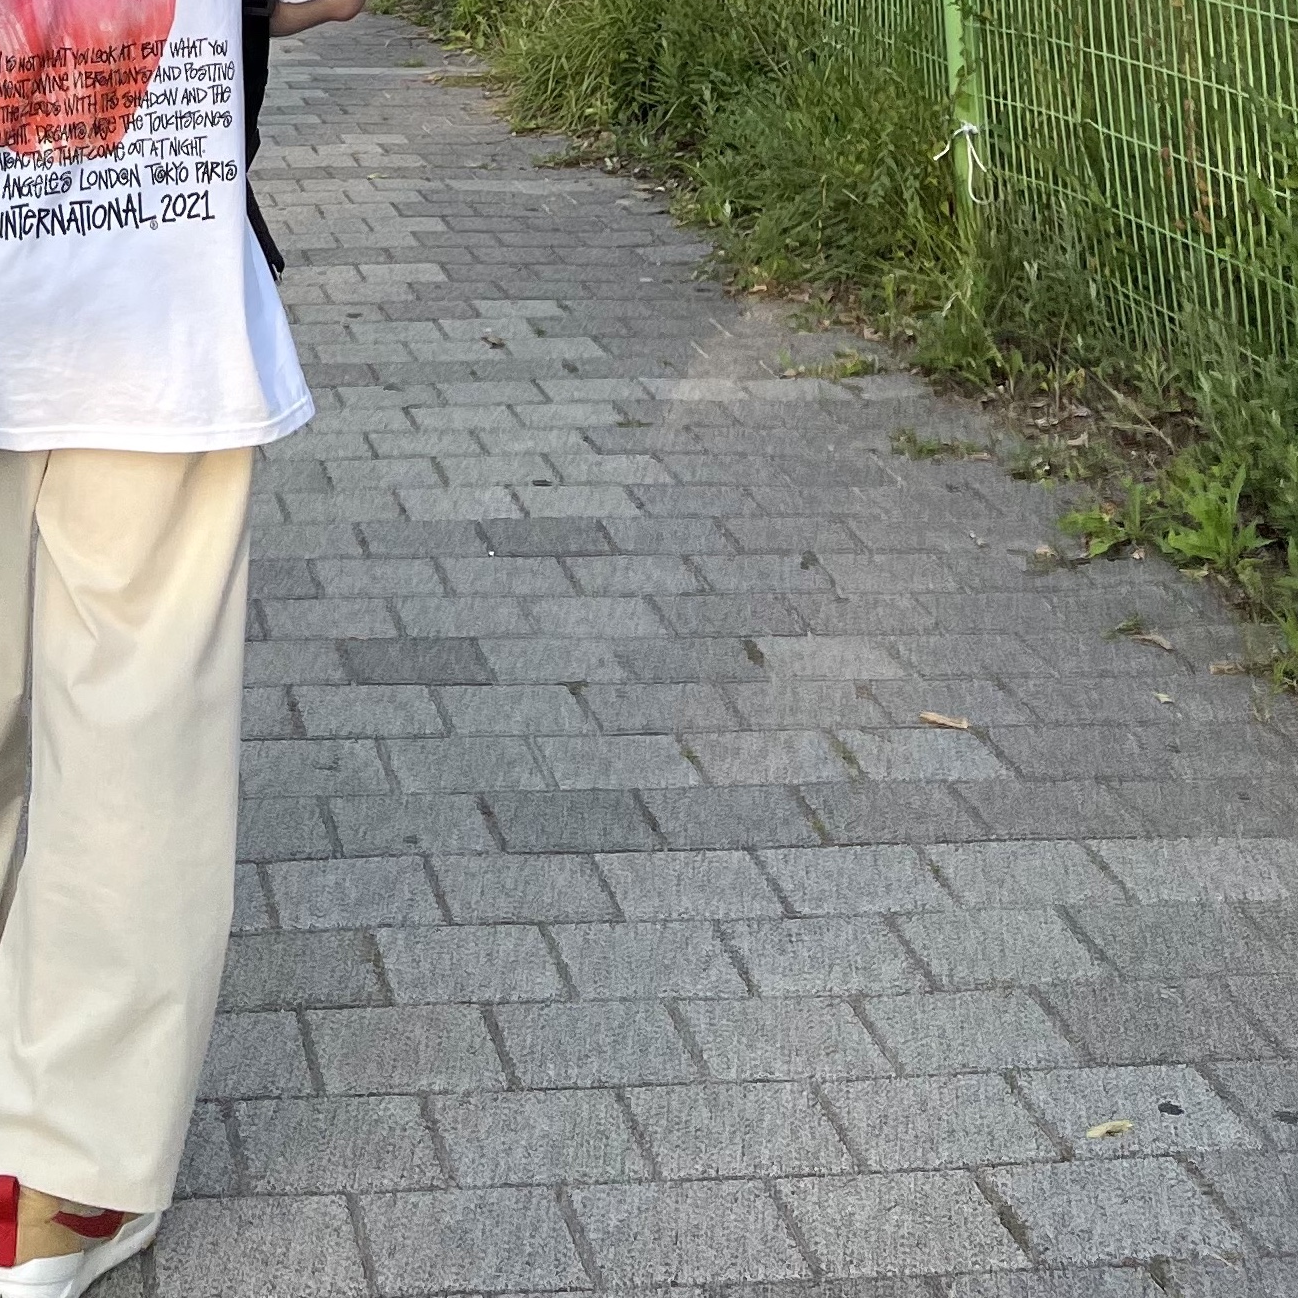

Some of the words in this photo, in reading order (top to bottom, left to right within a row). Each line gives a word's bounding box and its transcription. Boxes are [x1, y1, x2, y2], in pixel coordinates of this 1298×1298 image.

[5, 54, 17, 73] IS
[39, 47, 72, 70] WHAT
[90, 45, 117, 65] LOOK
[140, 38, 168, 60] BUT
[169, 37, 208, 58] WHAT
[207, 39, 228, 57] YOU
[152, 64, 182, 84] AND
[184, 60, 236, 83] POSITIVE
[63, 93, 98, 117] WITH
[122, 86, 178, 110] SHADOW
[180, 86, 208, 106] AND
[208, 83, 233, 105] THE
[119, 112, 144, 134] THE
[54, 144, 89, 168] THAT
[86, 140, 126, 165] COME
[127, 137, 154, 159] OUT
[151, 136, 170, 160] AT
[1, 170, 73, 201] ANGELES
[79, 163, 142, 192] LONDON
[144, 160, 190, 186] TOKYO
[194, 159, 238, 185] PARIS
[160, 189, 216, 223] 2021
